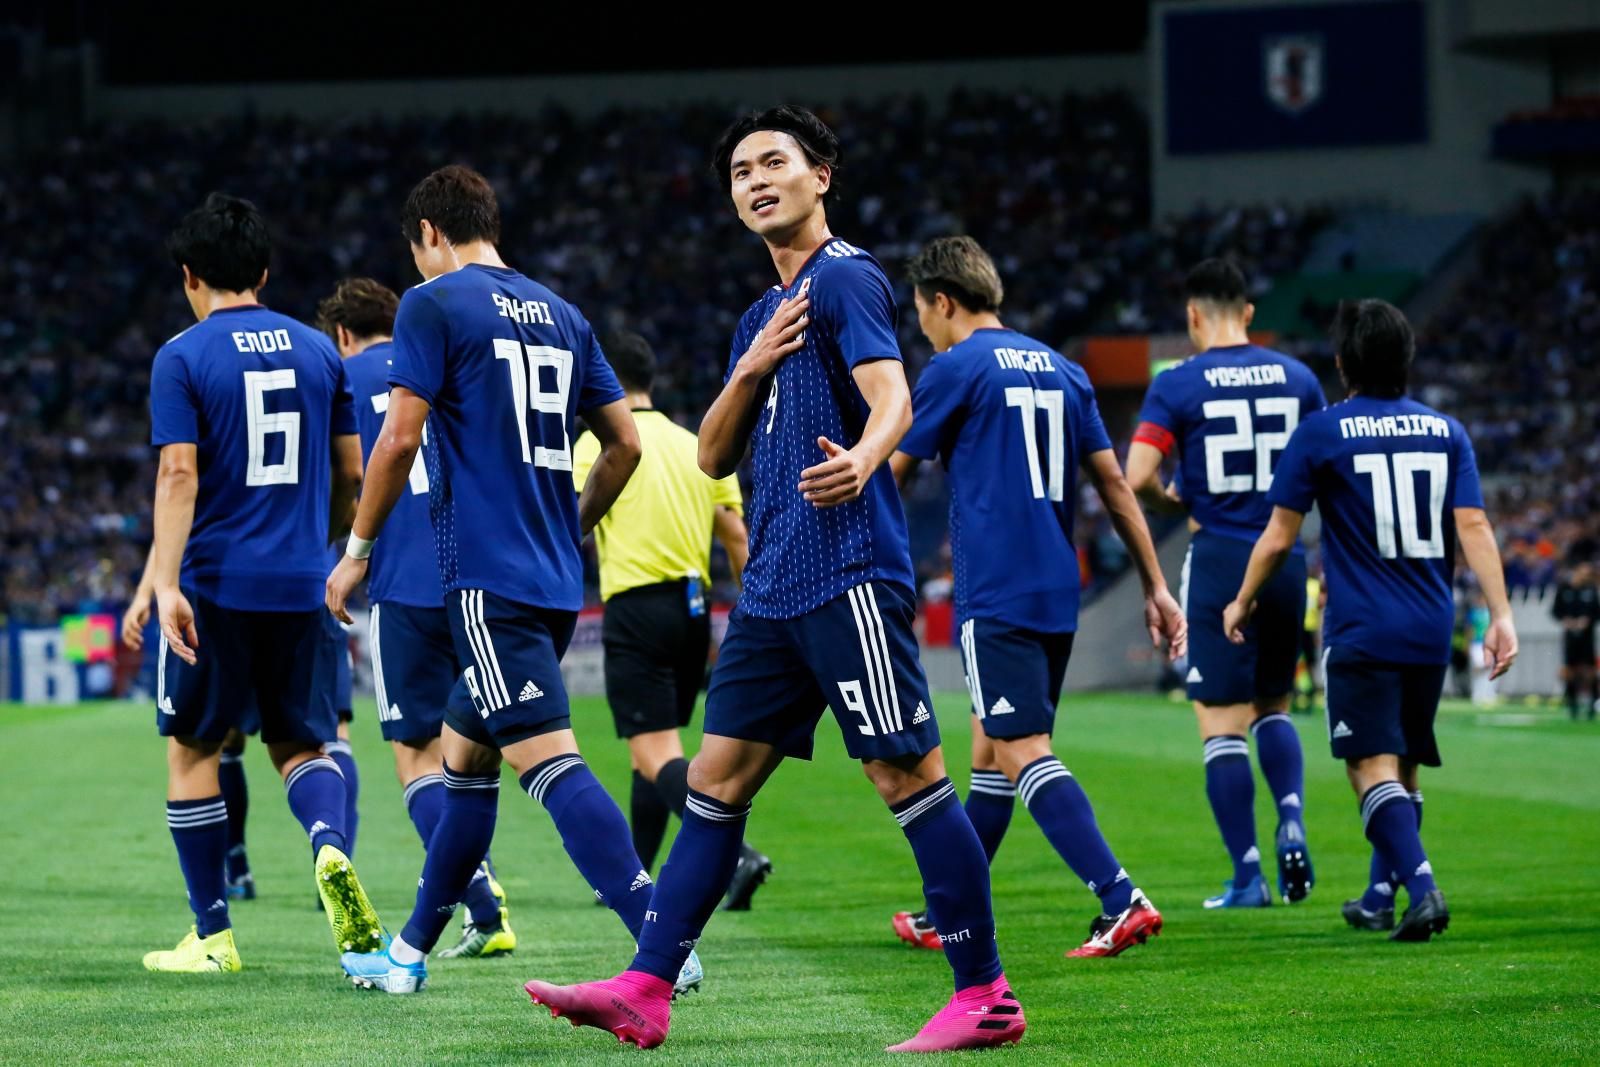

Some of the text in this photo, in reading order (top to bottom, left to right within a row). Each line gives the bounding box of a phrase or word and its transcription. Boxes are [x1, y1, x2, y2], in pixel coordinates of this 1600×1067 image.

[492, 293, 554, 326] SAKAI
[231, 329, 293, 353] ENDO
[994, 348, 1056, 373] NAGAI
[1204, 364, 1287, 388] YOSHIDA
[243, 368, 301, 486] 6
[492, 338, 574, 472] 19
[1339, 414, 1450, 439] NAKAJIMA
[1004, 387, 1064, 502] 11
[1203, 397, 1299, 494] 22
[1353, 452, 1448, 559] 10
[837, 679, 876, 736] 9
[936, 928, 971, 944] PAN
